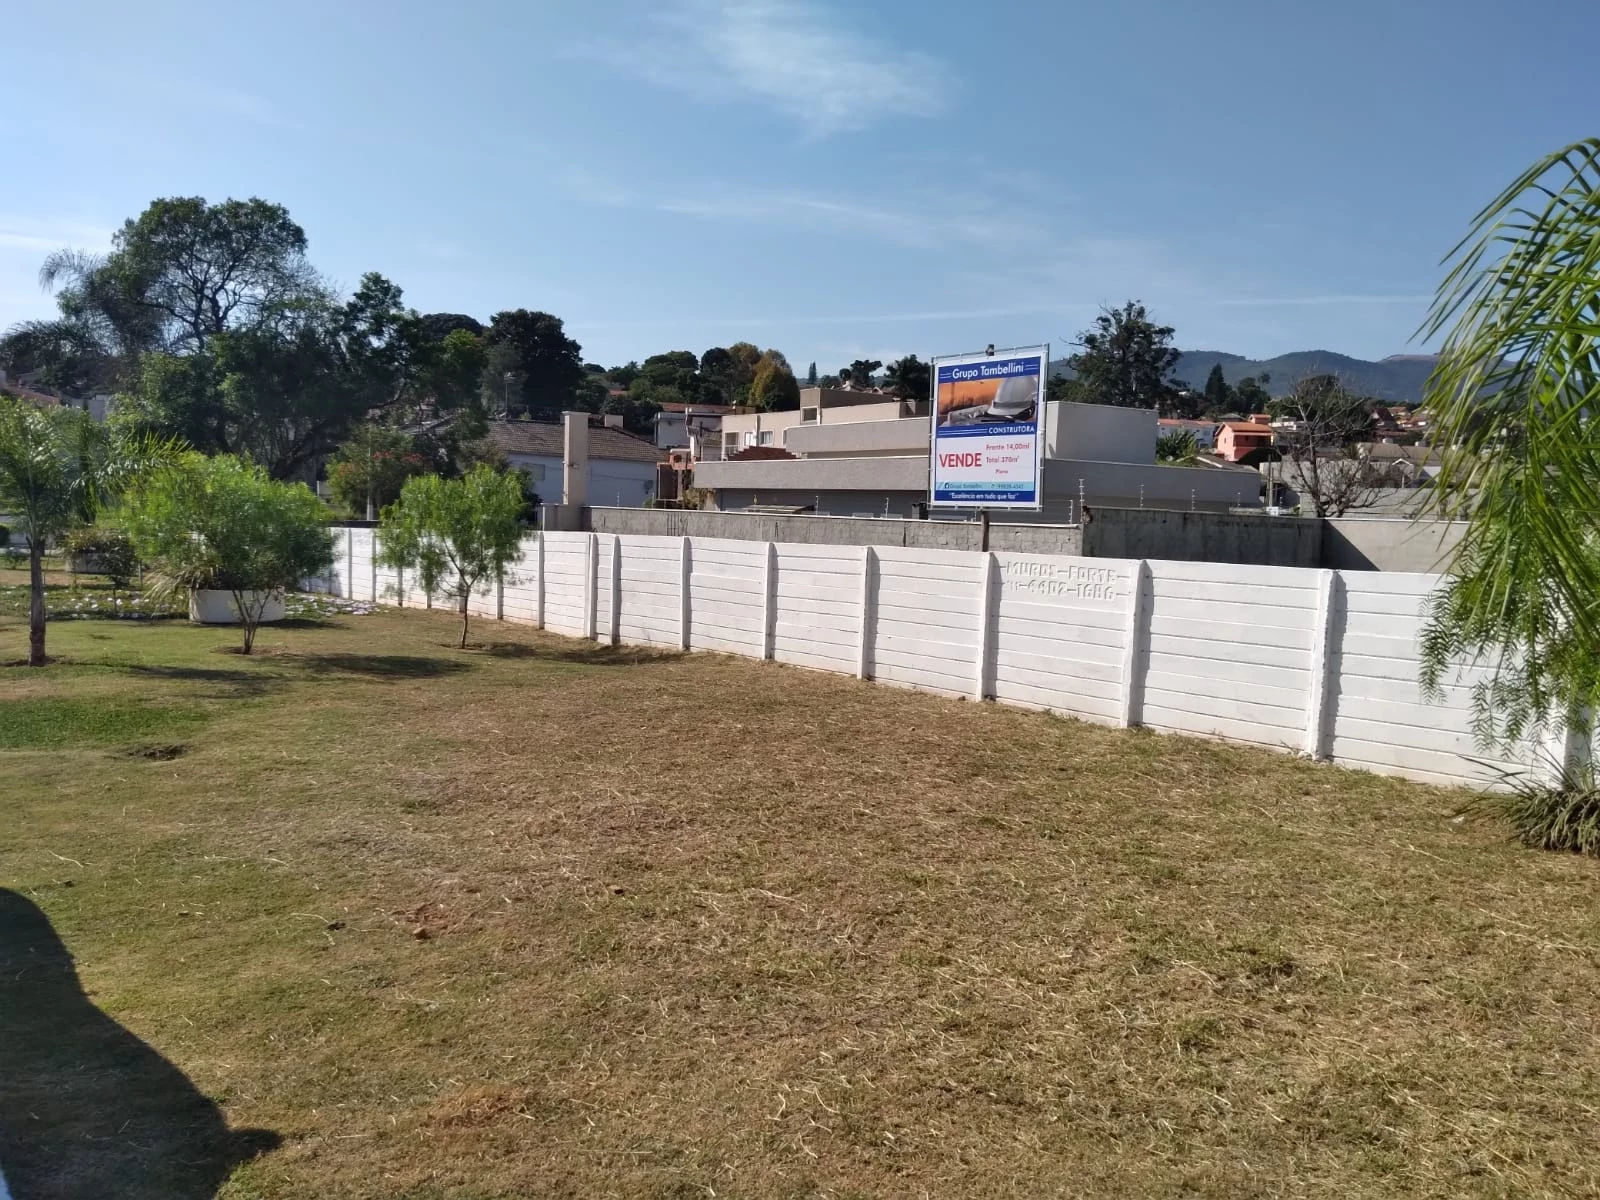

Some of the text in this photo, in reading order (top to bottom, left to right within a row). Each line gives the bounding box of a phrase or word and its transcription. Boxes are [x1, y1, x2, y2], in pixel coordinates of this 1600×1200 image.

[952, 361, 1025, 380] Grupo Tambellini
[988, 425, 1035, 434] CONSTRUTORA
[939, 453, 982, 468] VENDE
